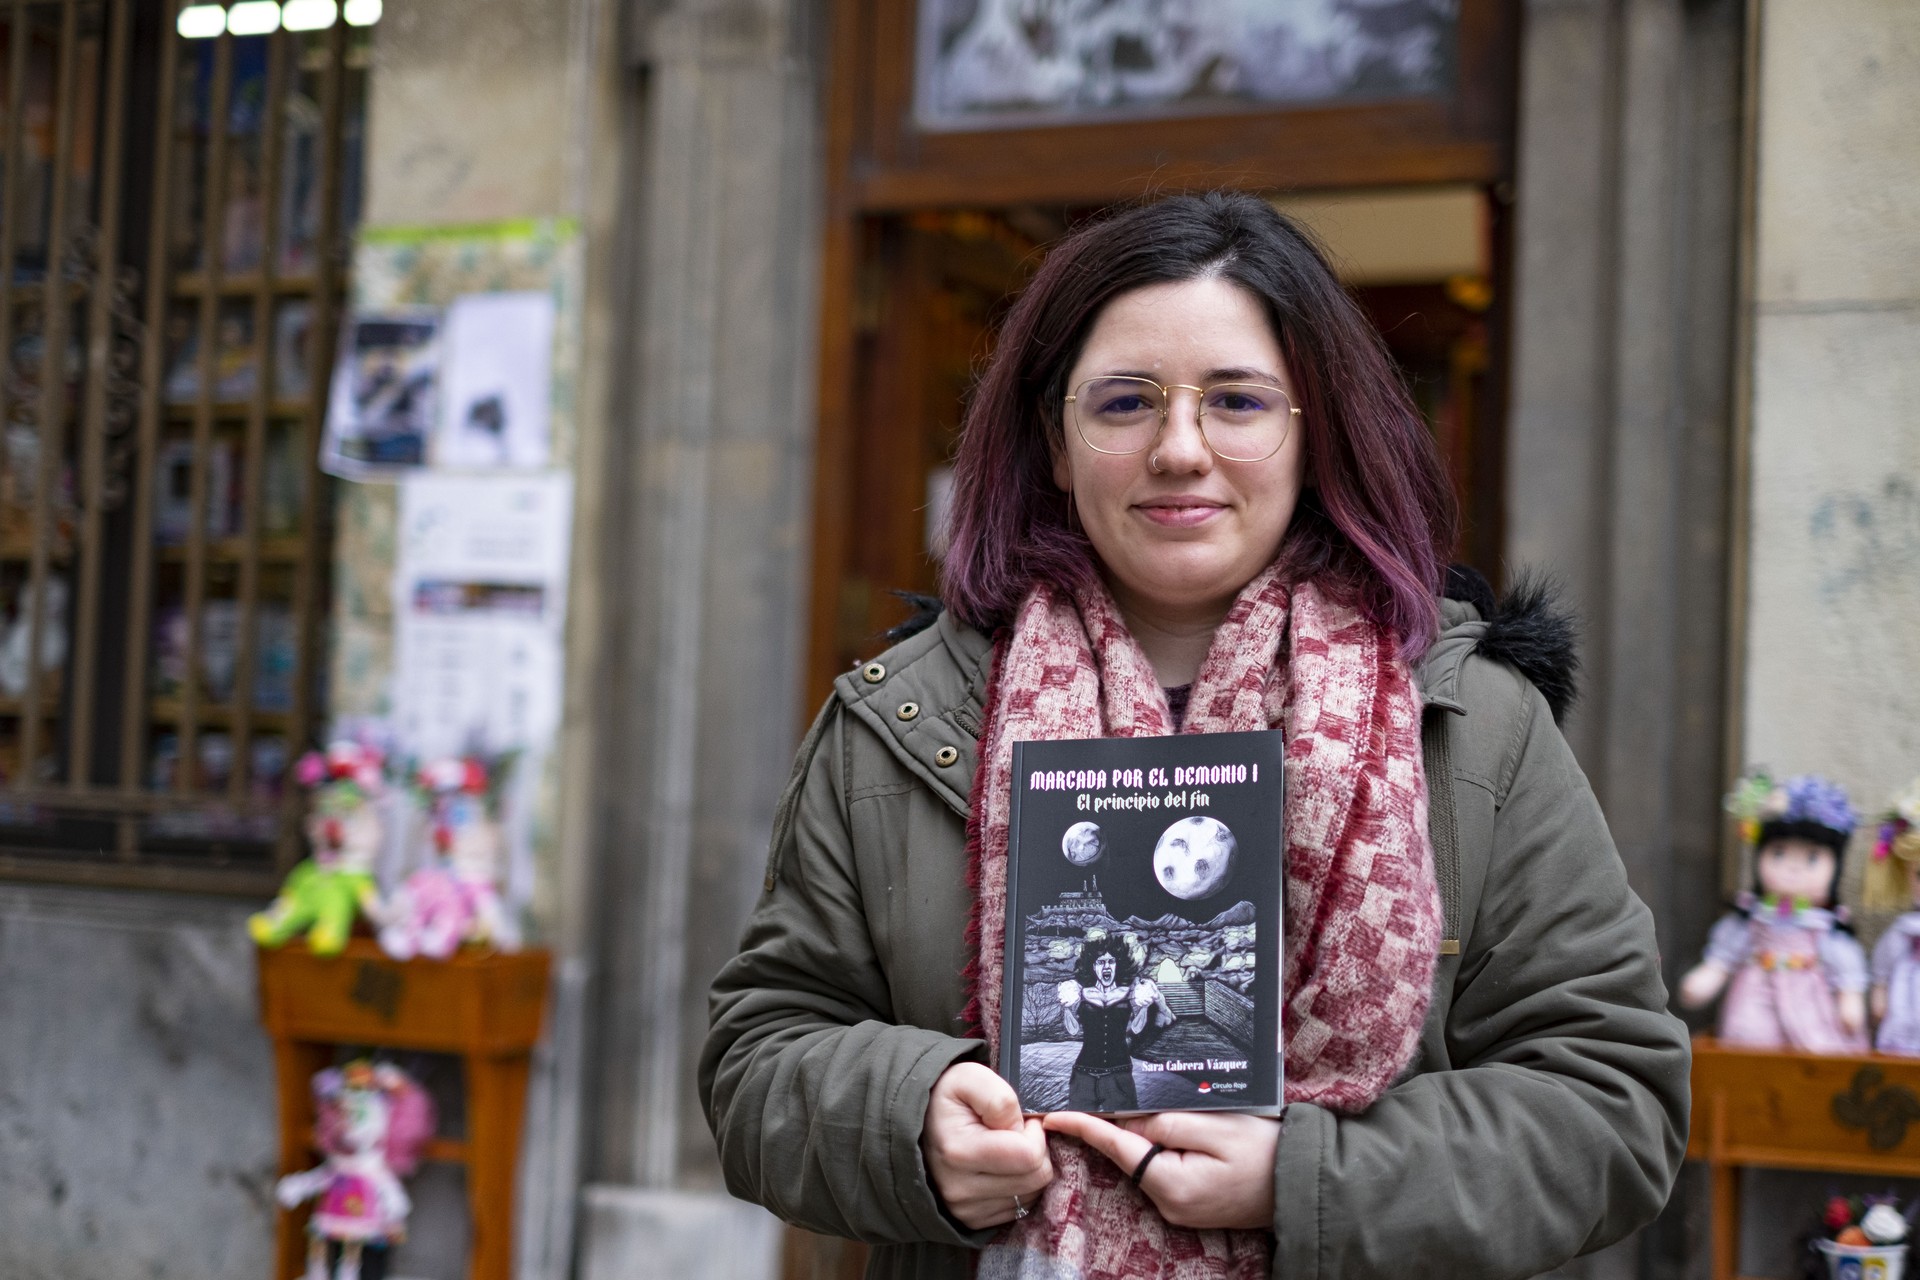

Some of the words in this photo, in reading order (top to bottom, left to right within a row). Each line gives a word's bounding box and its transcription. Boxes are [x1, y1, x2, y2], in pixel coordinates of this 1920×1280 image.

[1030, 769, 1107, 791] MARCADA
[1112, 768, 1143, 789] POR
[1148, 767, 1169, 787] EL
[1174, 764, 1247, 786] DEMONIO
[1077, 793, 1091, 811] El
[1094, 791, 1160, 813] principio
[1164, 790, 1187, 808] del
[1190, 789, 1210, 810] fin
[1142, 1061, 1164, 1072] Sara
[1166, 1060, 1204, 1071] Cabrera
[1206, 1059, 1247, 1072] Vázquez
[1233, 1082, 1247, 1090] Rojo
